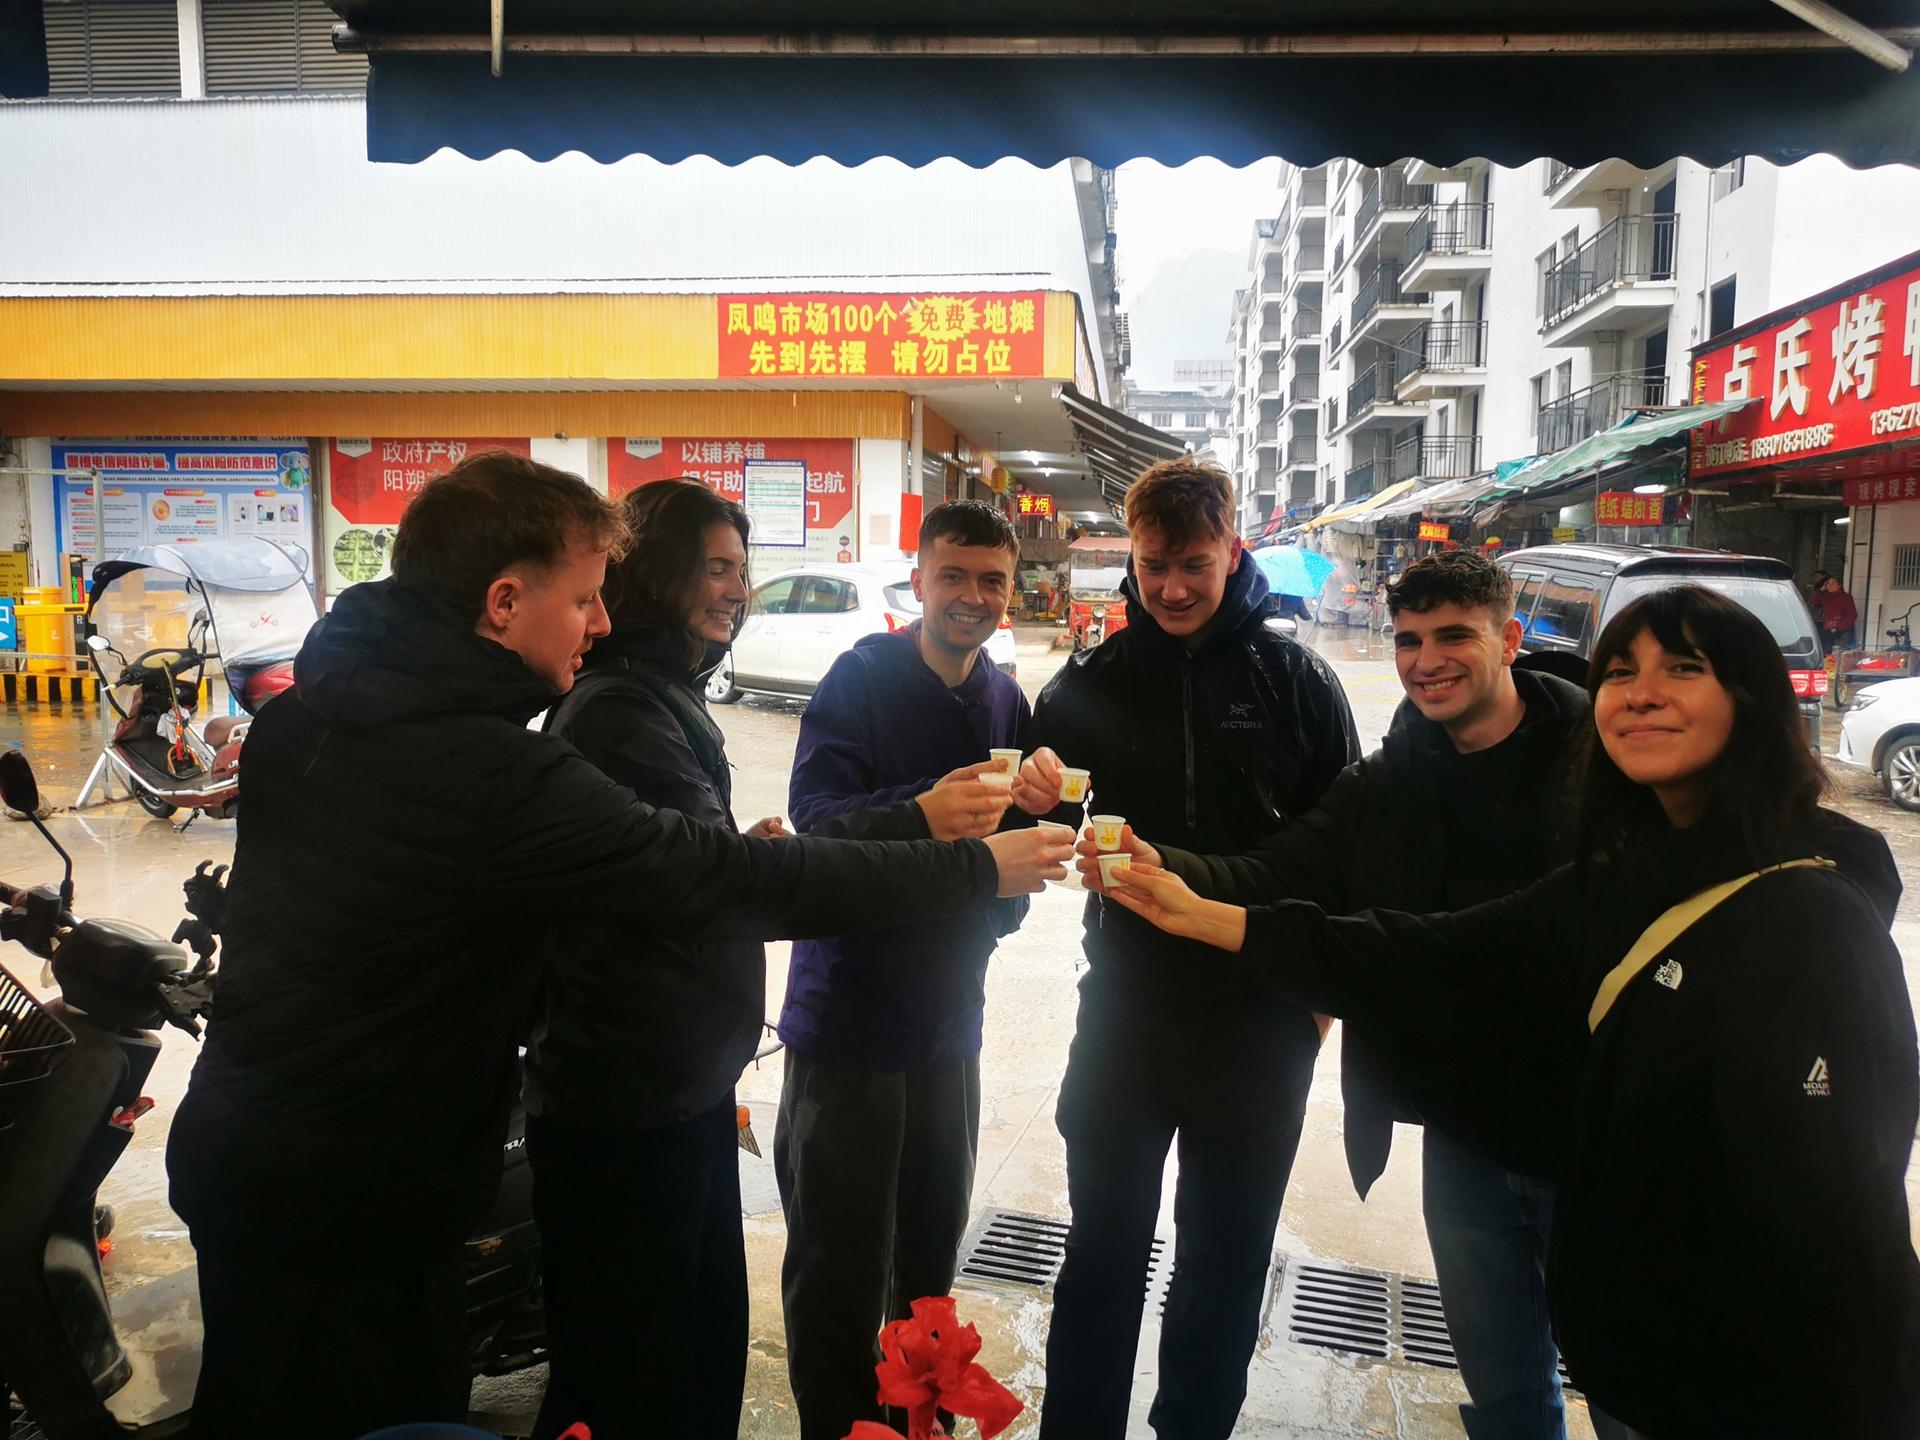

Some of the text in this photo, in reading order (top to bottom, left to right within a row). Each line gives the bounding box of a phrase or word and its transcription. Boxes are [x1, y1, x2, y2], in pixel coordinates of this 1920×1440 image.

[727, 299, 1035, 336] 凤鸣市场100个 免费 地摊
[749, 340, 1012, 375] 先到先摆 请勿占位
[382, 440, 468, 464] 政府产权
[681, 441, 767, 464] 以铺养铺
[805, 471, 847, 494] 起航
[1019, 495, 1050, 514] 香烟
[1649, 497, 1661, 521] 香
